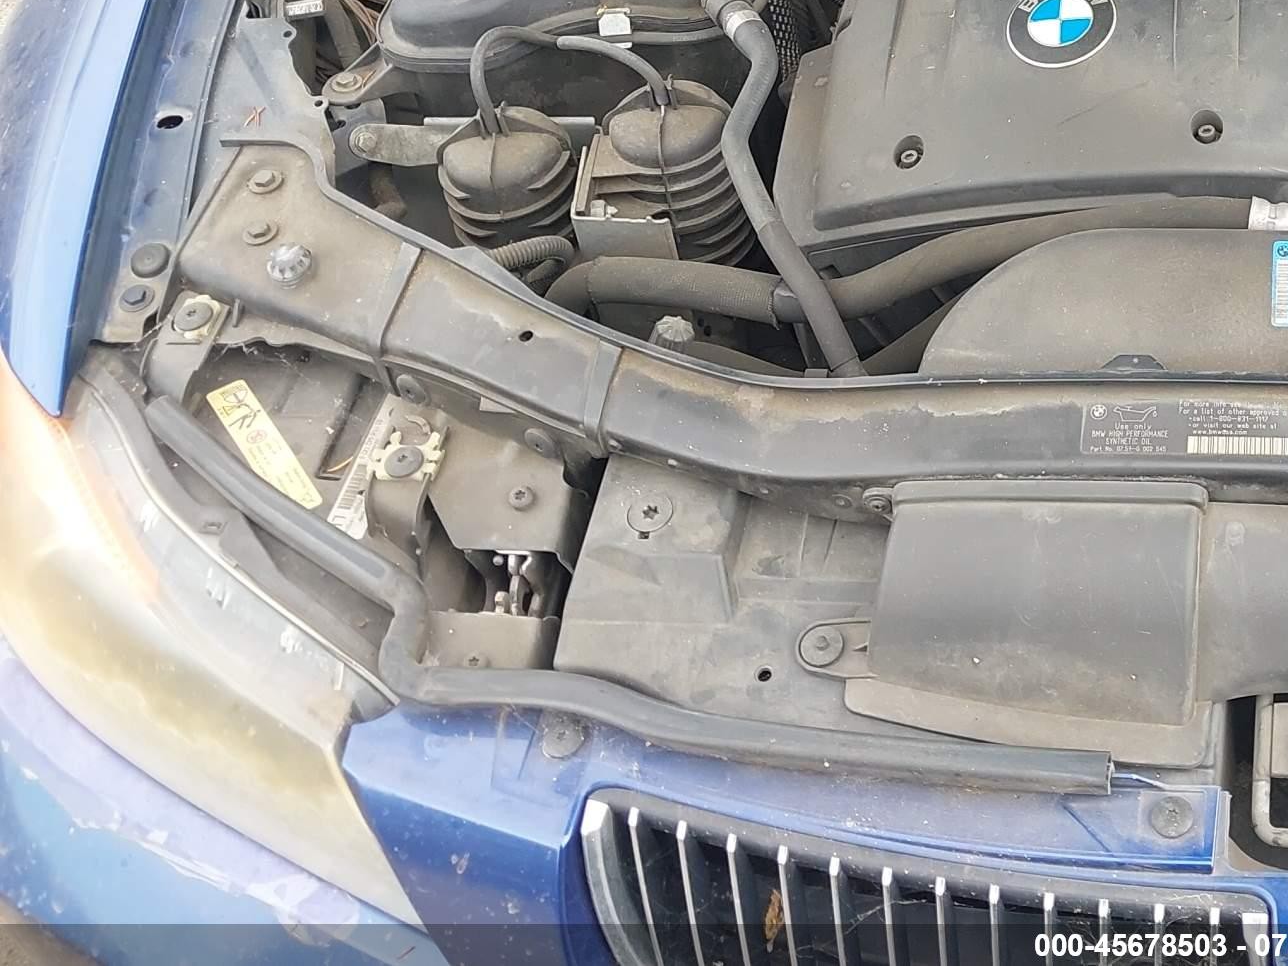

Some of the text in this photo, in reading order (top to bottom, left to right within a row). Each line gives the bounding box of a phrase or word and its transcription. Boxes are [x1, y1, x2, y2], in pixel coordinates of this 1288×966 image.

[1114, 422, 1152, 430] Use only
[1091, 430, 1169, 438] BMW HIGH PERFORMANCE
